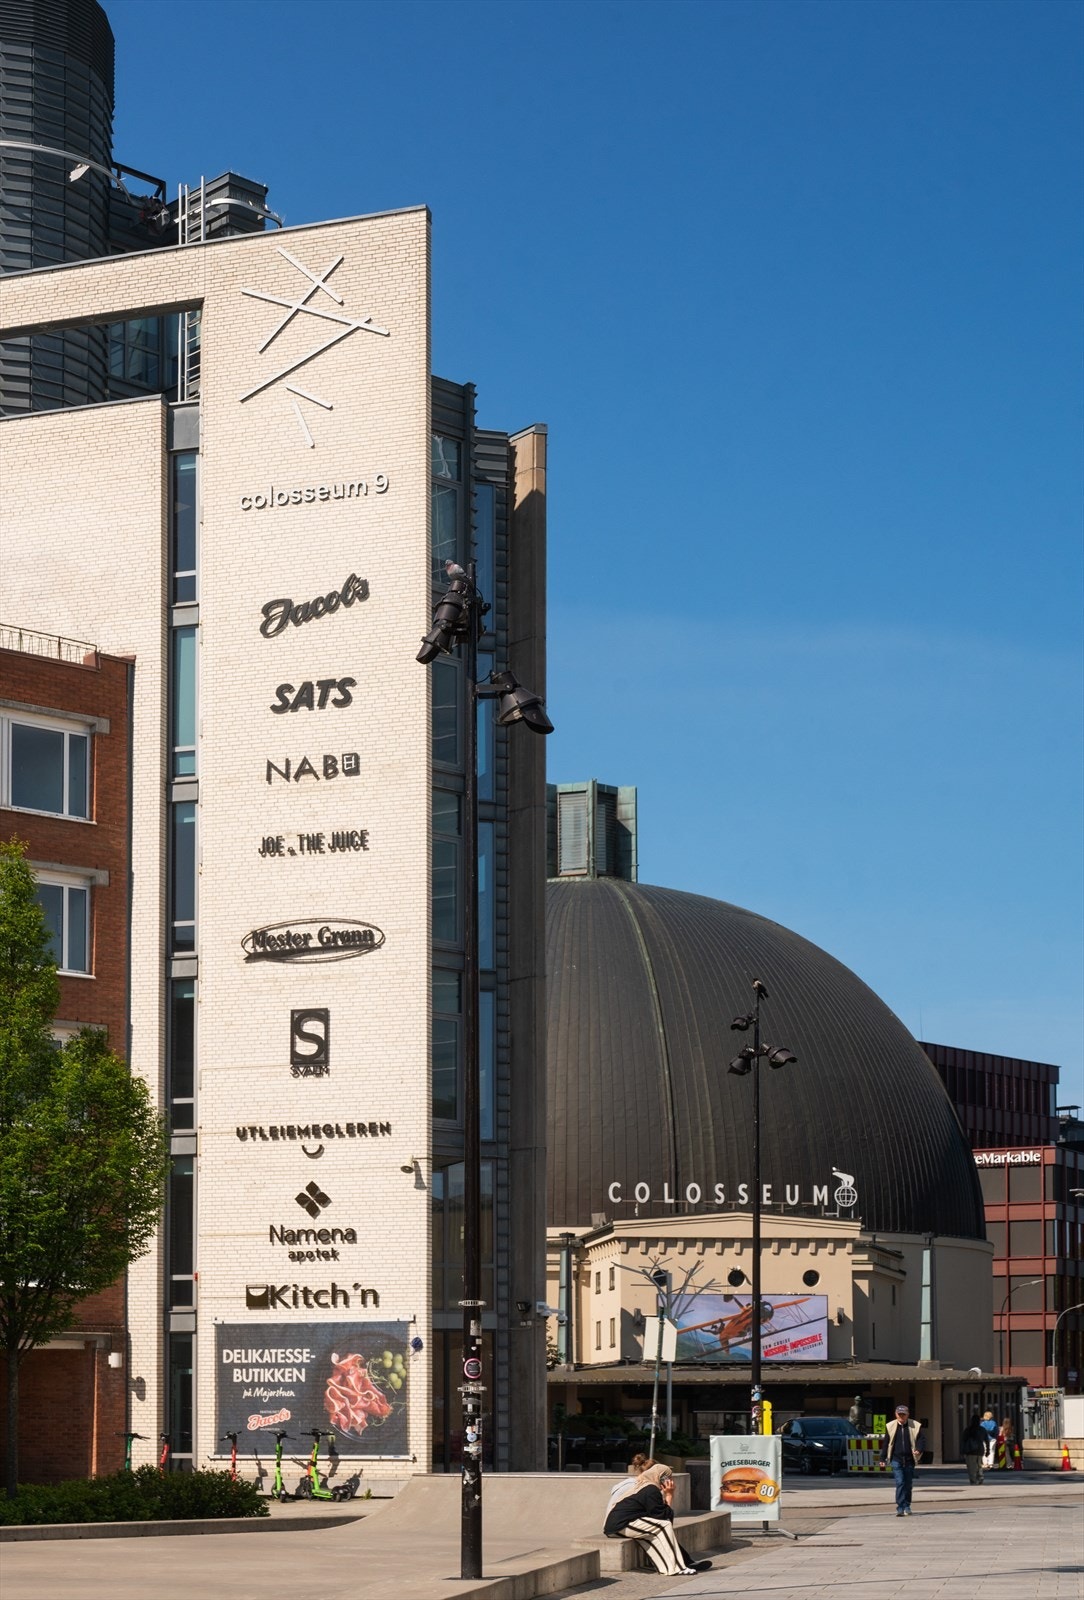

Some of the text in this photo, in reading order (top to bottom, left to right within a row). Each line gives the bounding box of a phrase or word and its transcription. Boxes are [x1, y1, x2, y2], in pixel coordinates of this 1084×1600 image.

[240, 474, 390, 511] colosseum 9
[259, 573, 370, 638] Jacob's
[270, 677, 358, 715] SATS
[258, 835, 285, 858] JOE
[297, 832, 326, 855] THE
[328, 829, 370, 853] JUICE
[251, 925, 376, 952] Mester Grønn
[236, 1121, 392, 1141] UTLEIEMEGLEREN
[608, 1182, 828, 1206] COLOSSEUM
[269, 1224, 358, 1246] Namena
[288, 1247, 340, 1263] apotek
[222, 1348, 316, 1364] DELIKATESSE-
[233, 1367, 306, 1383] BUTIKKEN
[242, 1386, 295, 1402] på Majorstuen
[720, 1459, 771, 1468] CHEESEBURGER
[760, 1484, 775, 1498] 80
